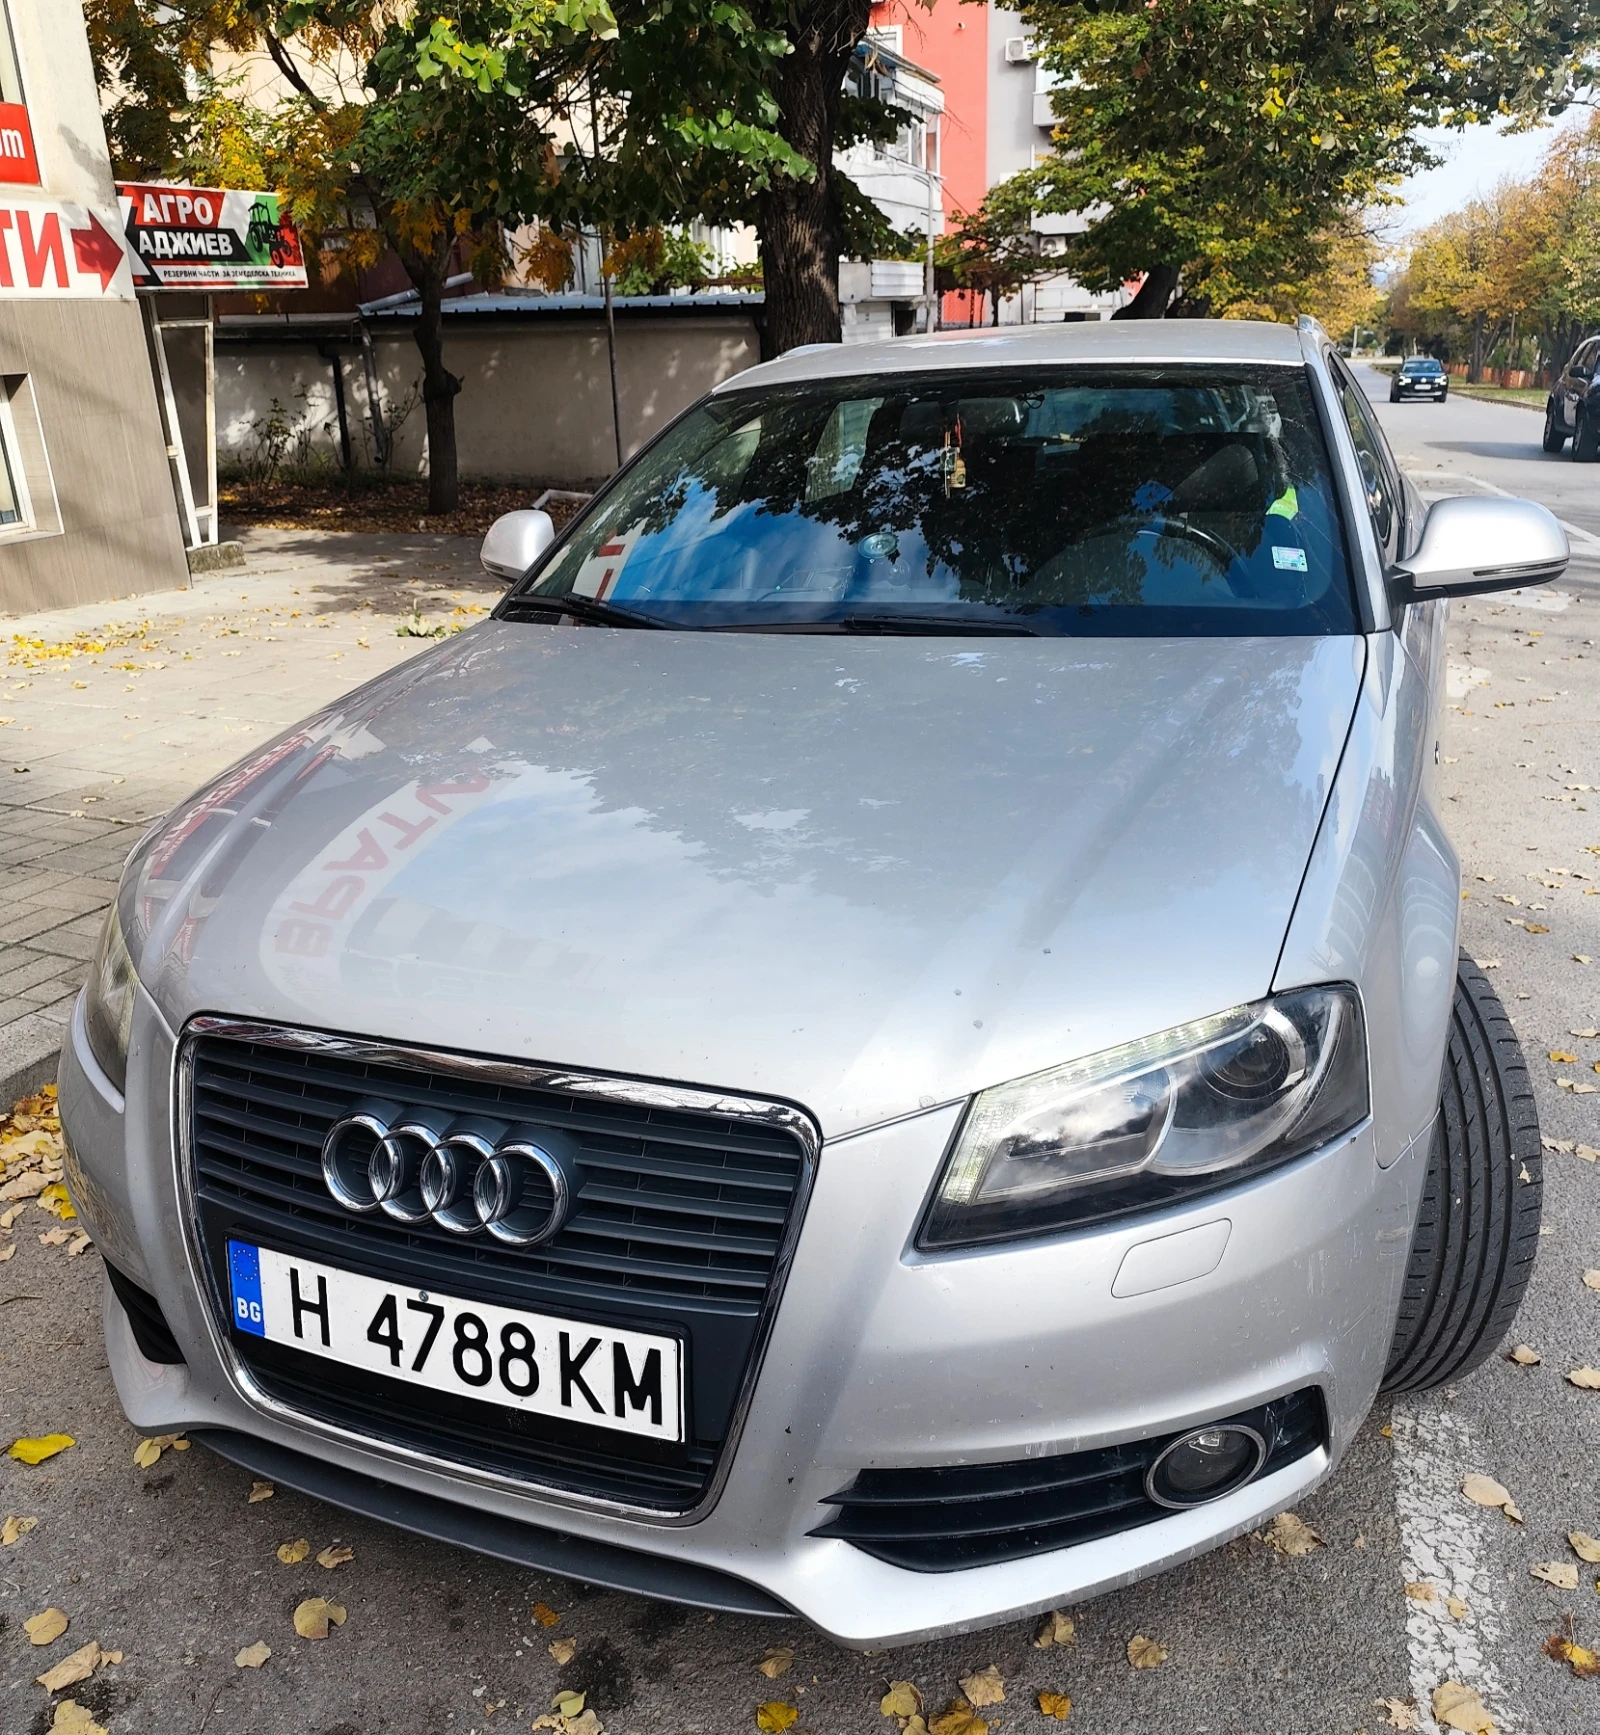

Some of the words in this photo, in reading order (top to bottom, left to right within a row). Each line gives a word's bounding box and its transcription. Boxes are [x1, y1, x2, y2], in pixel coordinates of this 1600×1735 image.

[0, 128, 25, 159] m
[143, 193, 214, 226] АГРО
[139, 230, 233, 259] АДЖИЕВ
[163, 270, 198, 278] РЕЗЕРВНИ
[236, 1296, 261, 1324] BG
[289, 1267, 331, 1348] H
[366, 1294, 540, 1398] 4788
[559, 1331, 663, 1426] KM
